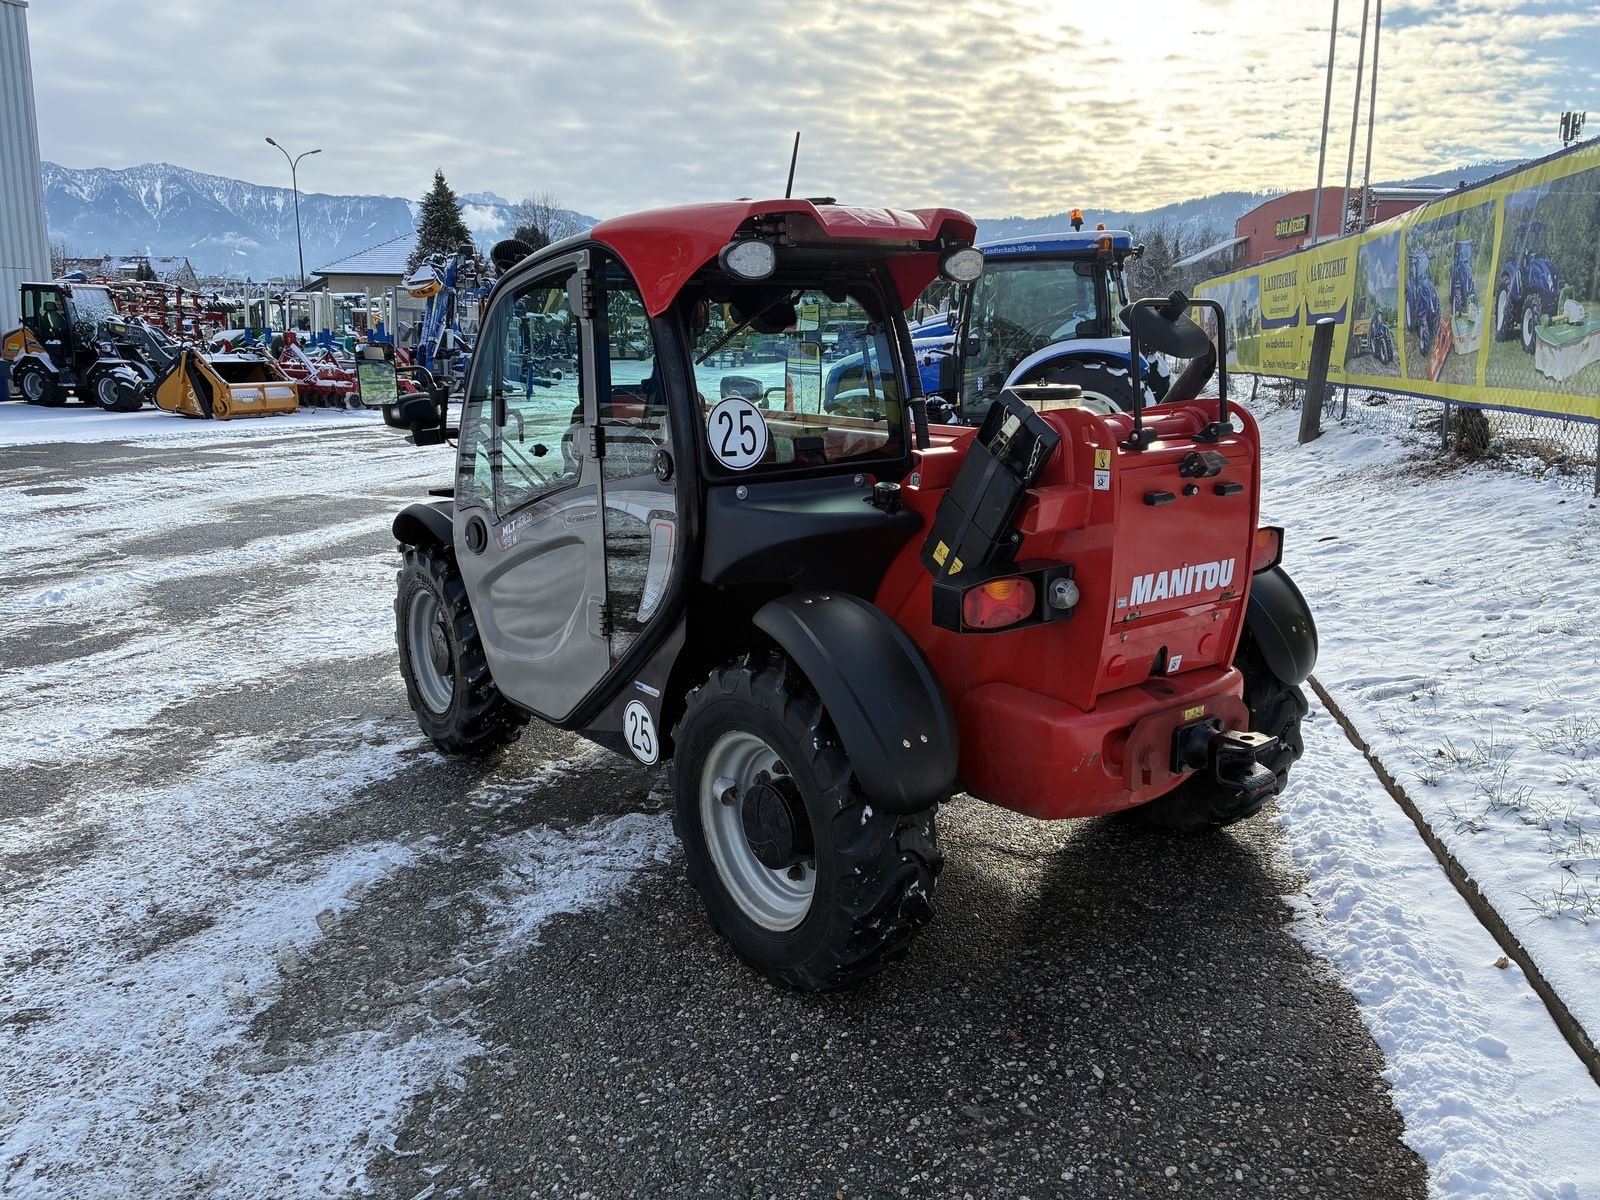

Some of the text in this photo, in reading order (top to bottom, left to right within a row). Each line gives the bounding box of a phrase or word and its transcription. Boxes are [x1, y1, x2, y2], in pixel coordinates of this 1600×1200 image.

[1263, 270, 1298, 292] LANDTECHNIK
[718, 409, 757, 457] 25
[502, 519, 517, 537] MLT
[1129, 558, 1236, 607] MANITOU
[630, 711, 652, 755] 25
